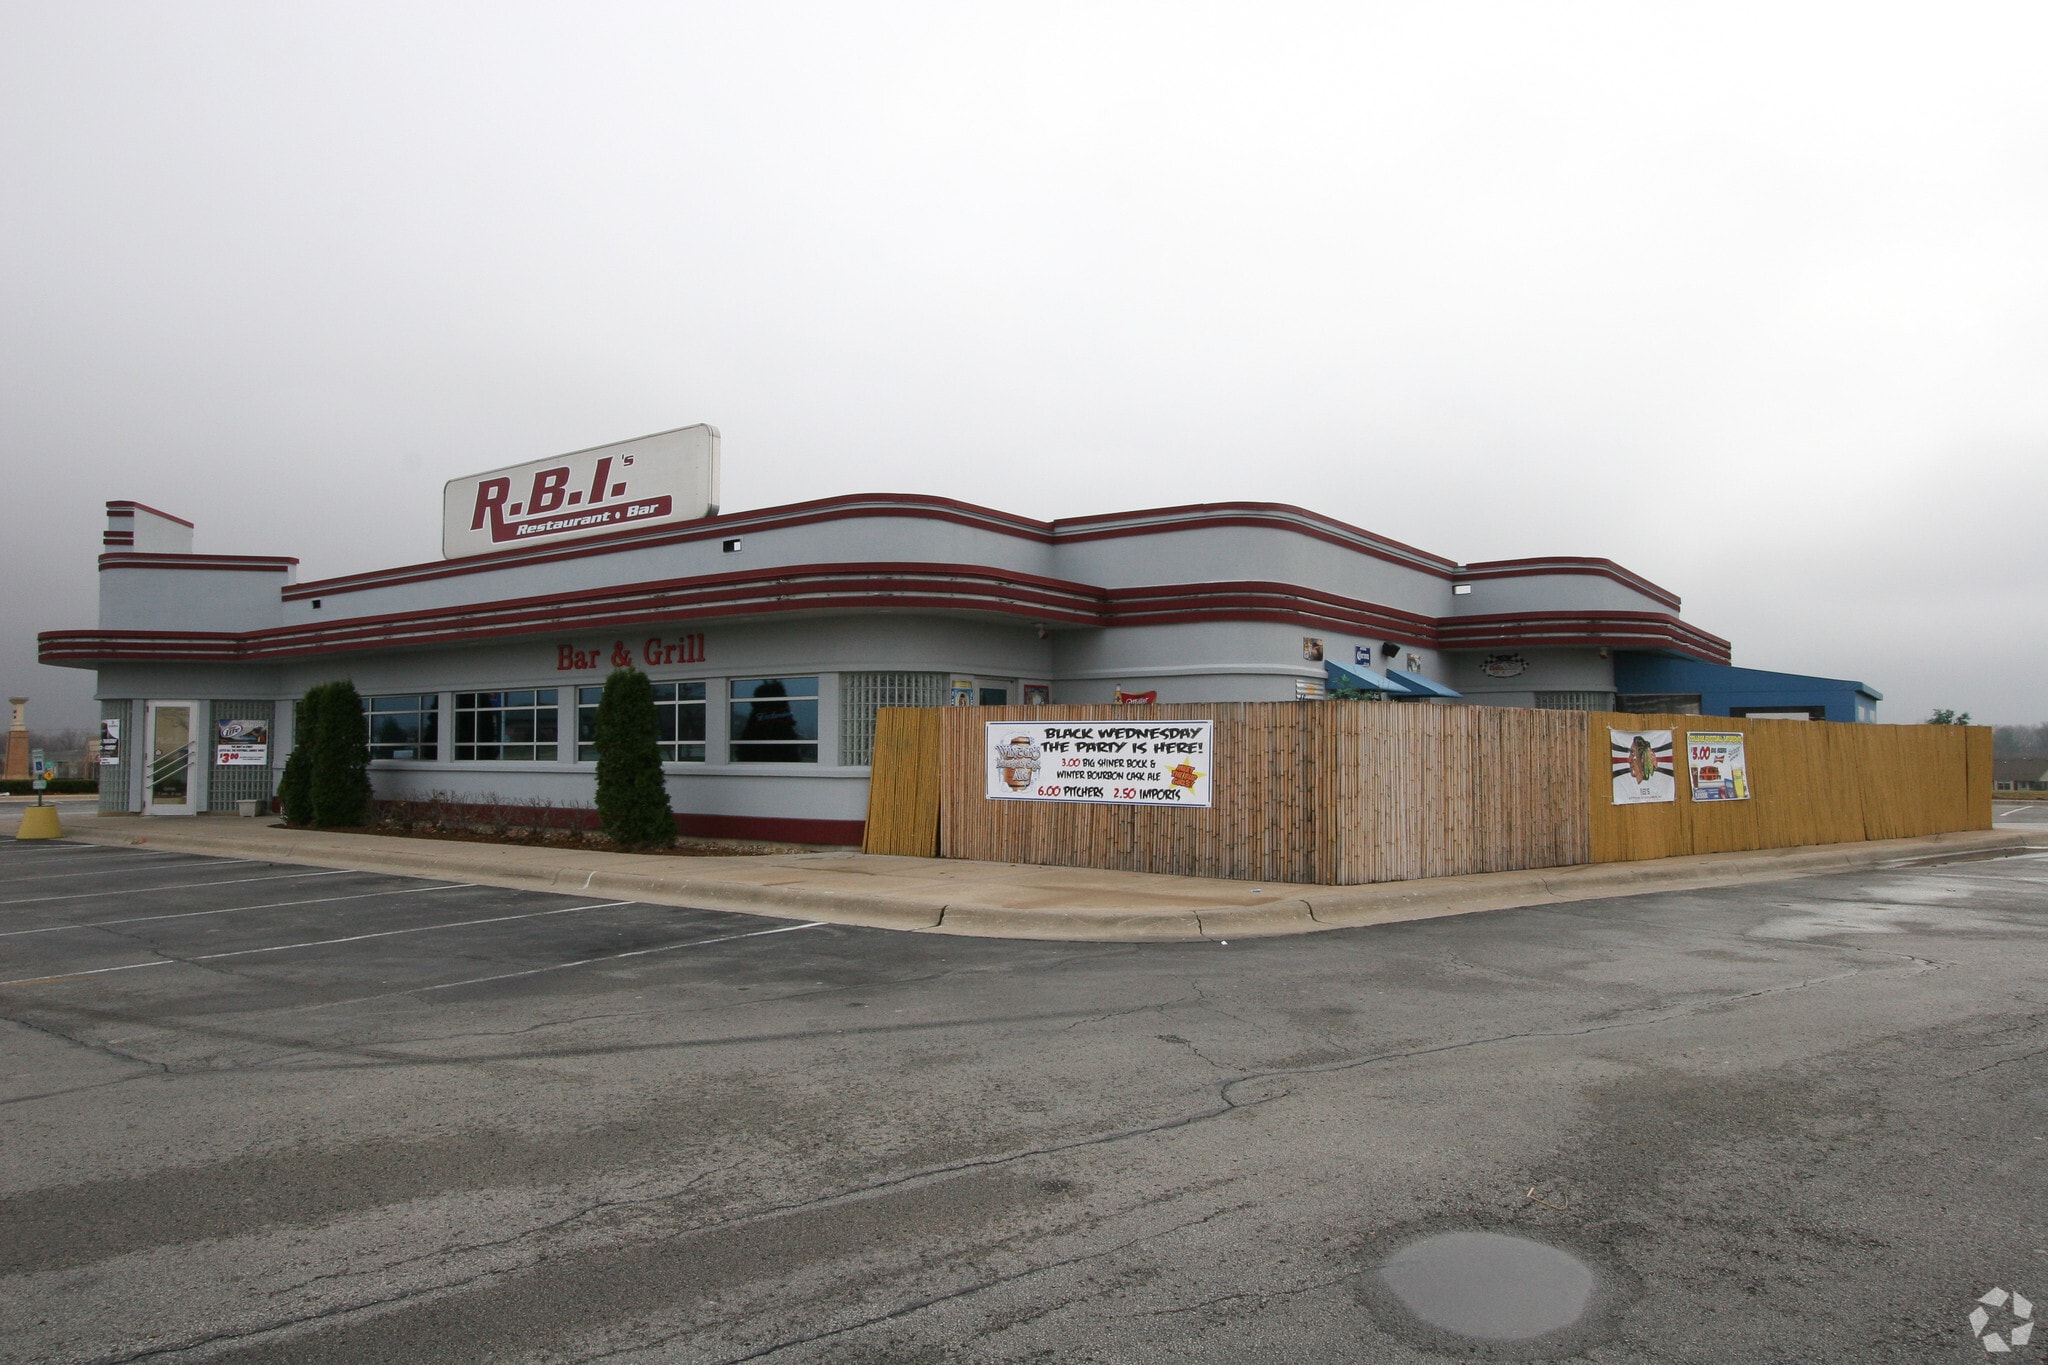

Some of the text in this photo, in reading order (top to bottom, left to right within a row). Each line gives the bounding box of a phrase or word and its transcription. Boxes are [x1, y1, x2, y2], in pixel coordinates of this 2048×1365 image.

[516, 502, 660, 536] Restaurant Bar
[556, 633, 706, 670] Bar & Grill
[1044, 727, 1203, 740] BLACK WEDNESDAY
[1040, 741, 1203, 754] THE PARTY IS HERE!
[1061, 758, 1156, 768] 3.00 BIG SHINER BOCK &
[1056, 770, 1161, 781] WINTER BOURBON CASK ALE
[1038, 785, 1104, 798] 6.00 PITCHERS
[1113, 787, 1181, 801] 2.50 IMPORTS
